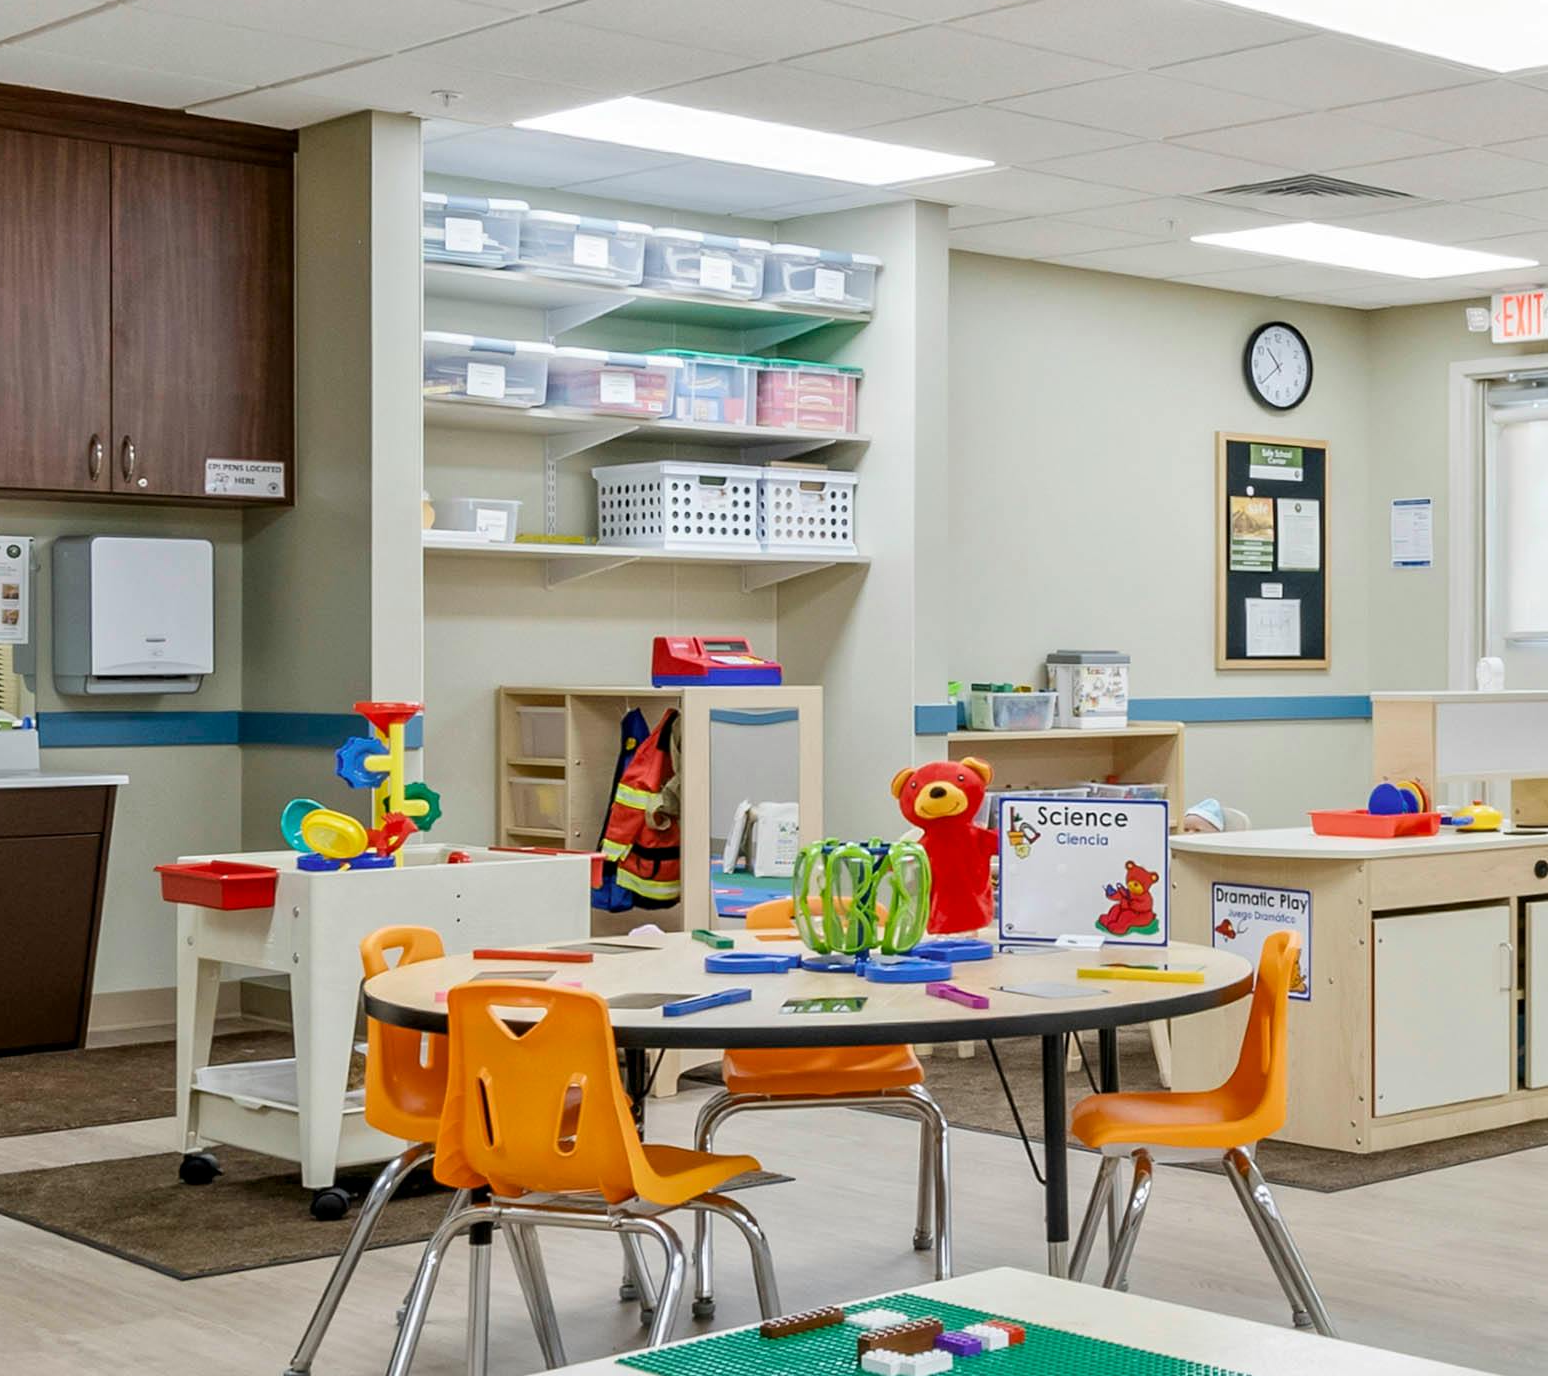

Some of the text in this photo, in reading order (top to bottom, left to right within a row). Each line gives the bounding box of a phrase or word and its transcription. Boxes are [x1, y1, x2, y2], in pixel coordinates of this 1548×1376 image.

[1502, 293, 1544, 337] EXIT
[1037, 806, 1129, 828] Science
[1056, 832, 1109, 846] Ciencia
[1216, 887, 1308, 914] Dramatic Play
